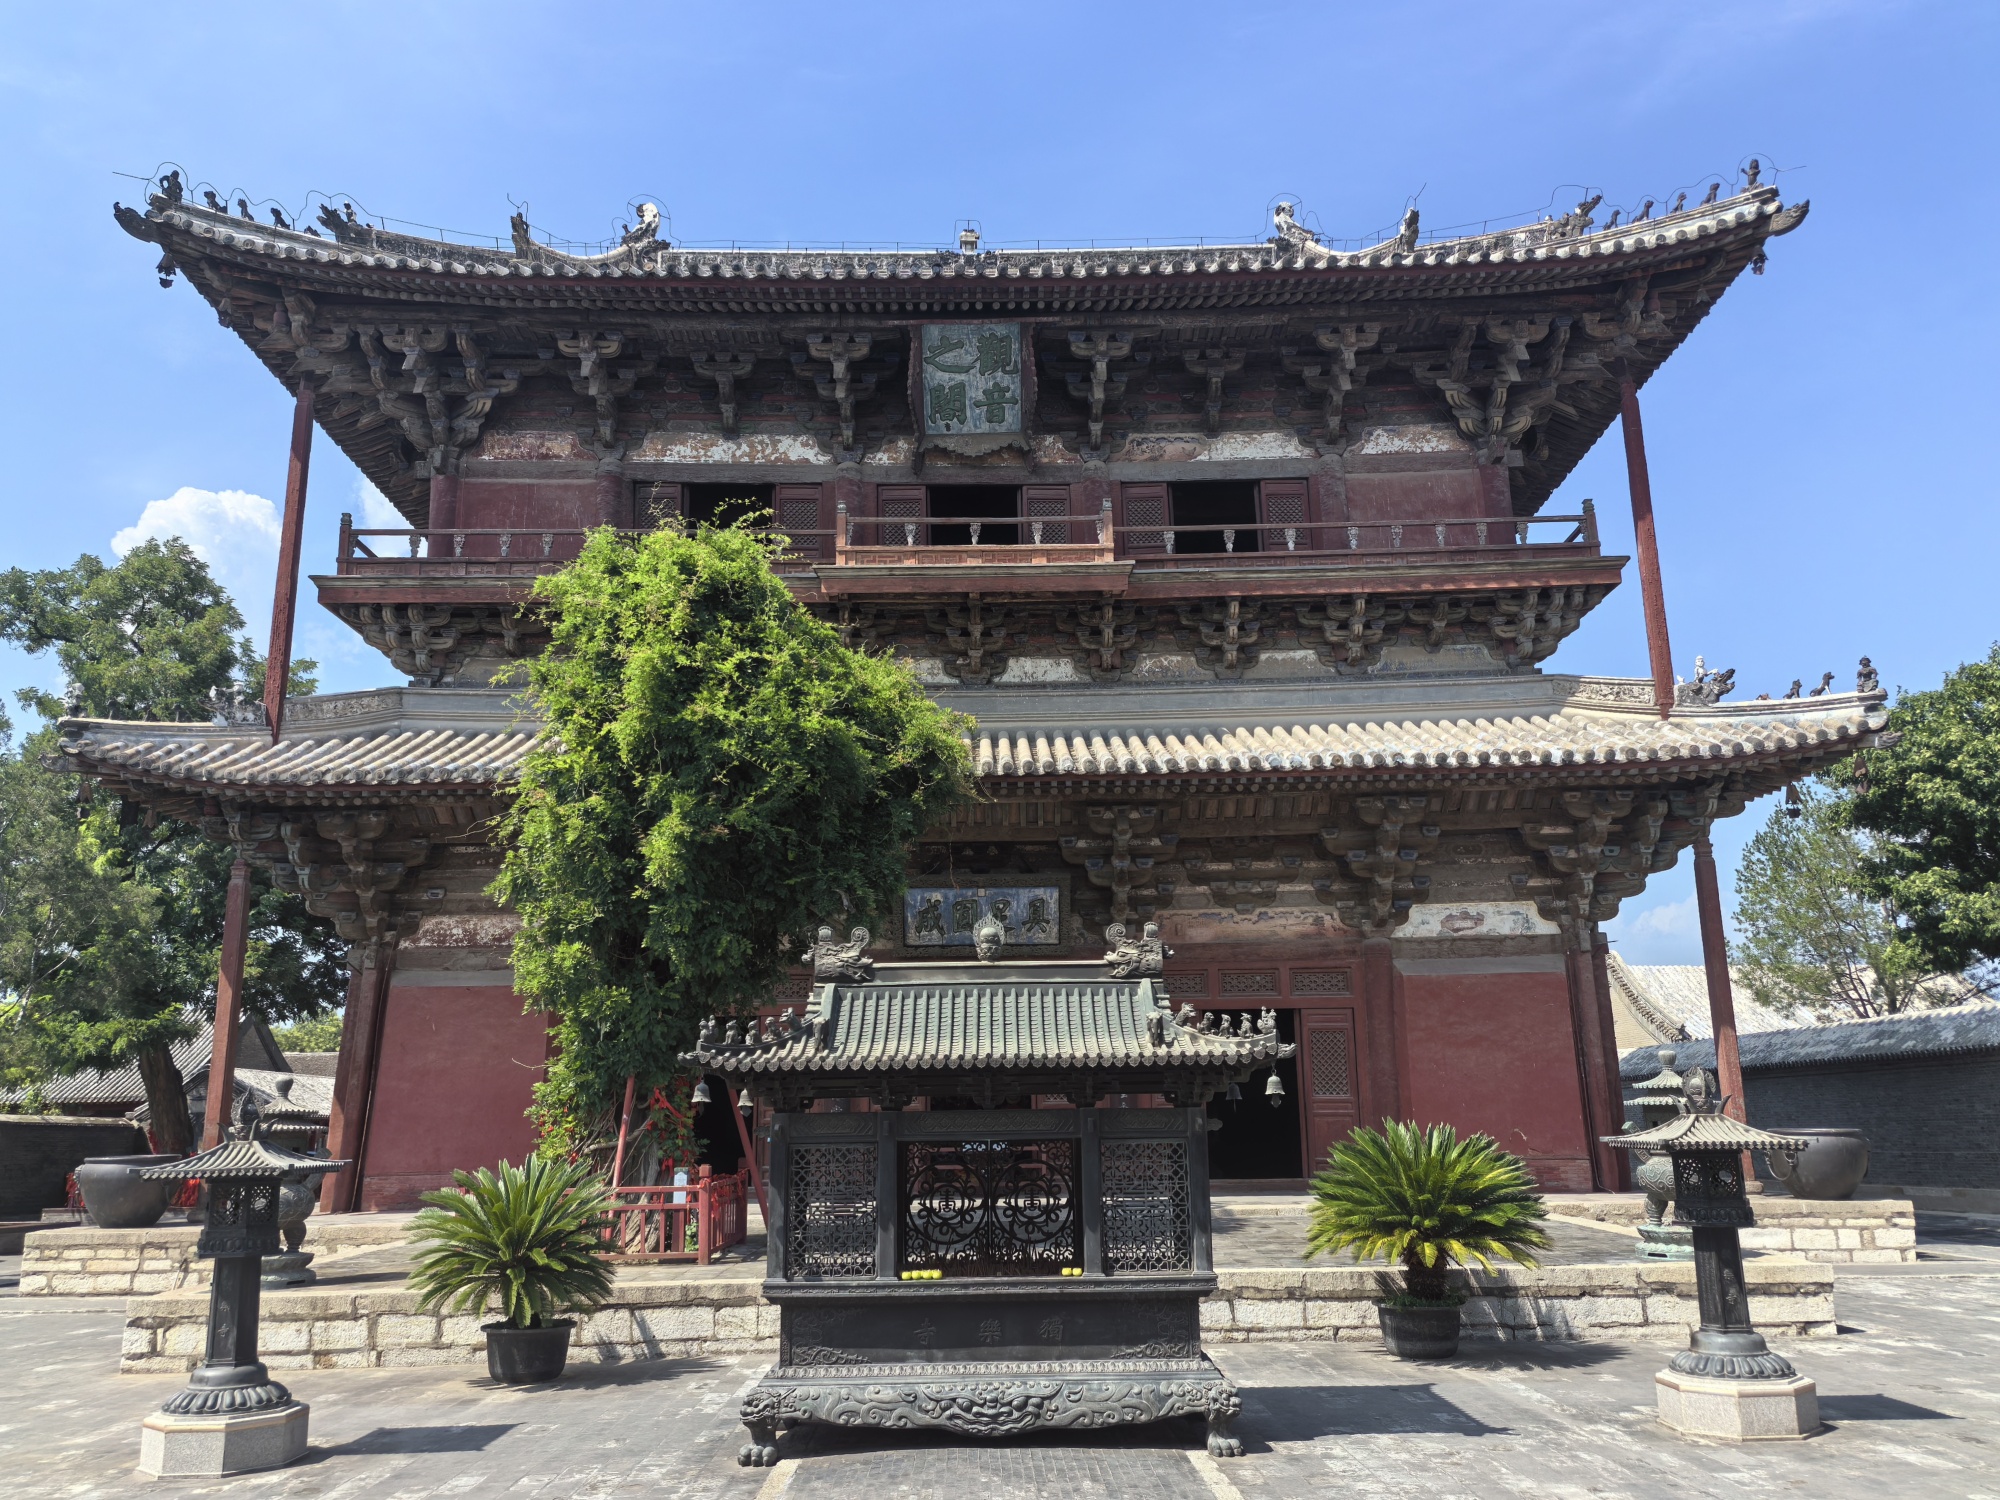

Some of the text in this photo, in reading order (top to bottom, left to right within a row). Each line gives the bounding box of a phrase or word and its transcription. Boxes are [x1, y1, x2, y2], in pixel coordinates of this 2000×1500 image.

[924, 335, 977, 425] 之閣
[971, 332, 1019, 425] 觀音
[912, 1316, 1065, 1346] 獨樂寺
